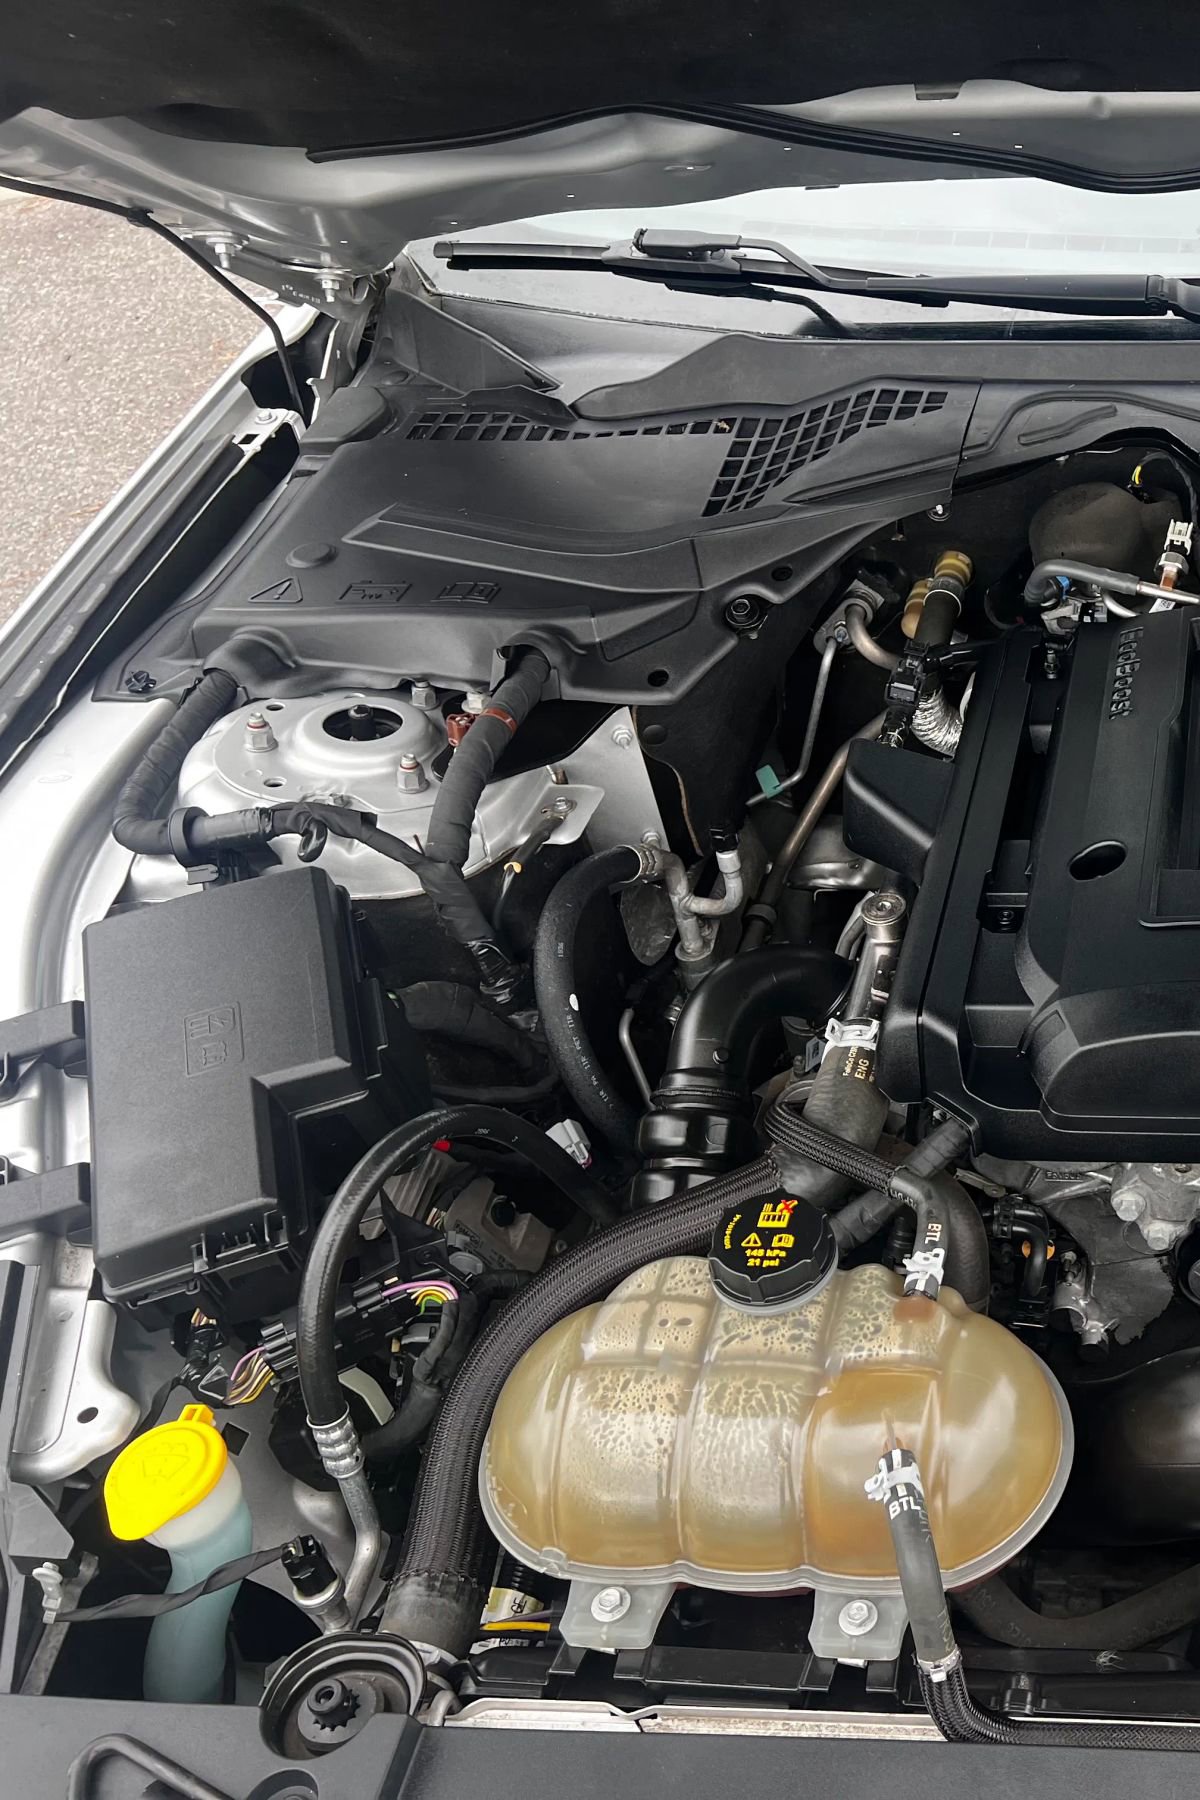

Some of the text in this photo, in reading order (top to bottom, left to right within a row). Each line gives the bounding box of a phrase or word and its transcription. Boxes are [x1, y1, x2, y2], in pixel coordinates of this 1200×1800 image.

[1109, 626, 1144, 720] EcoBoost
[854, 1058, 869, 1080] ENG
[924, 1223, 942, 1244] BTL
[745, 1249, 786, 1257] 145 kPa
[762, 1259, 780, 1268] psi
[889, 1496, 921, 1520] BTL
